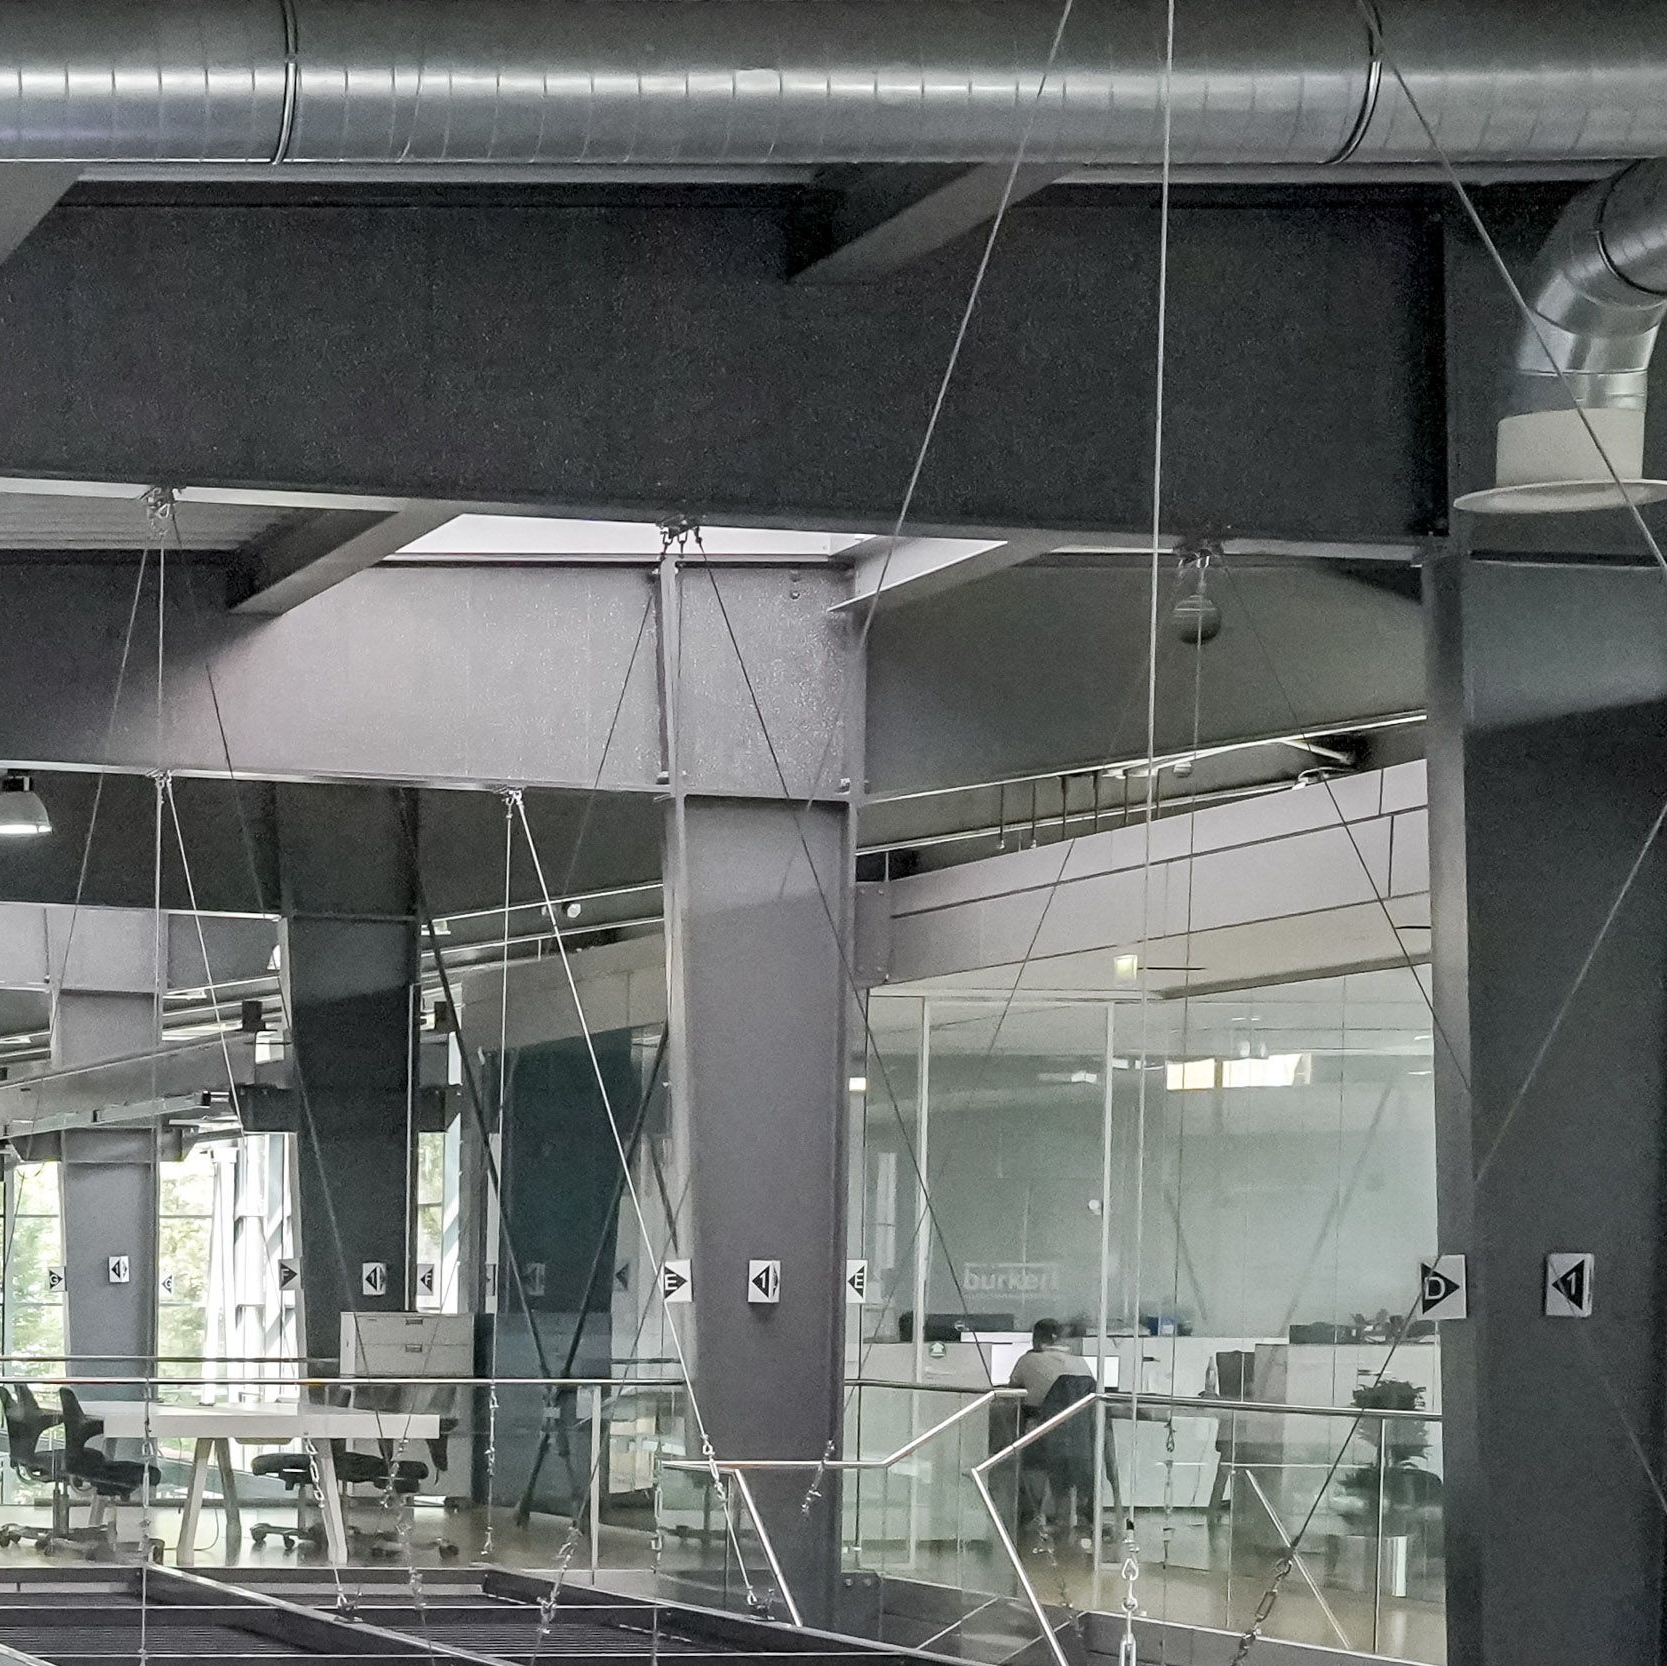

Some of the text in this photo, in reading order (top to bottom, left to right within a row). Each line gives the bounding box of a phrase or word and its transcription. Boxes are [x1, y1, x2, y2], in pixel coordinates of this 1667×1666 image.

[281, 1268, 290, 1282] F
[370, 1273, 376, 1284] 1
[424, 1273, 432, 1285] F
[664, 1274, 678, 1291] E
[759, 1273, 767, 1289] 1
[854, 1273, 864, 1288] E
[1424, 1276, 1446, 1300] D
[1566, 1272, 1576, 1296] 1
